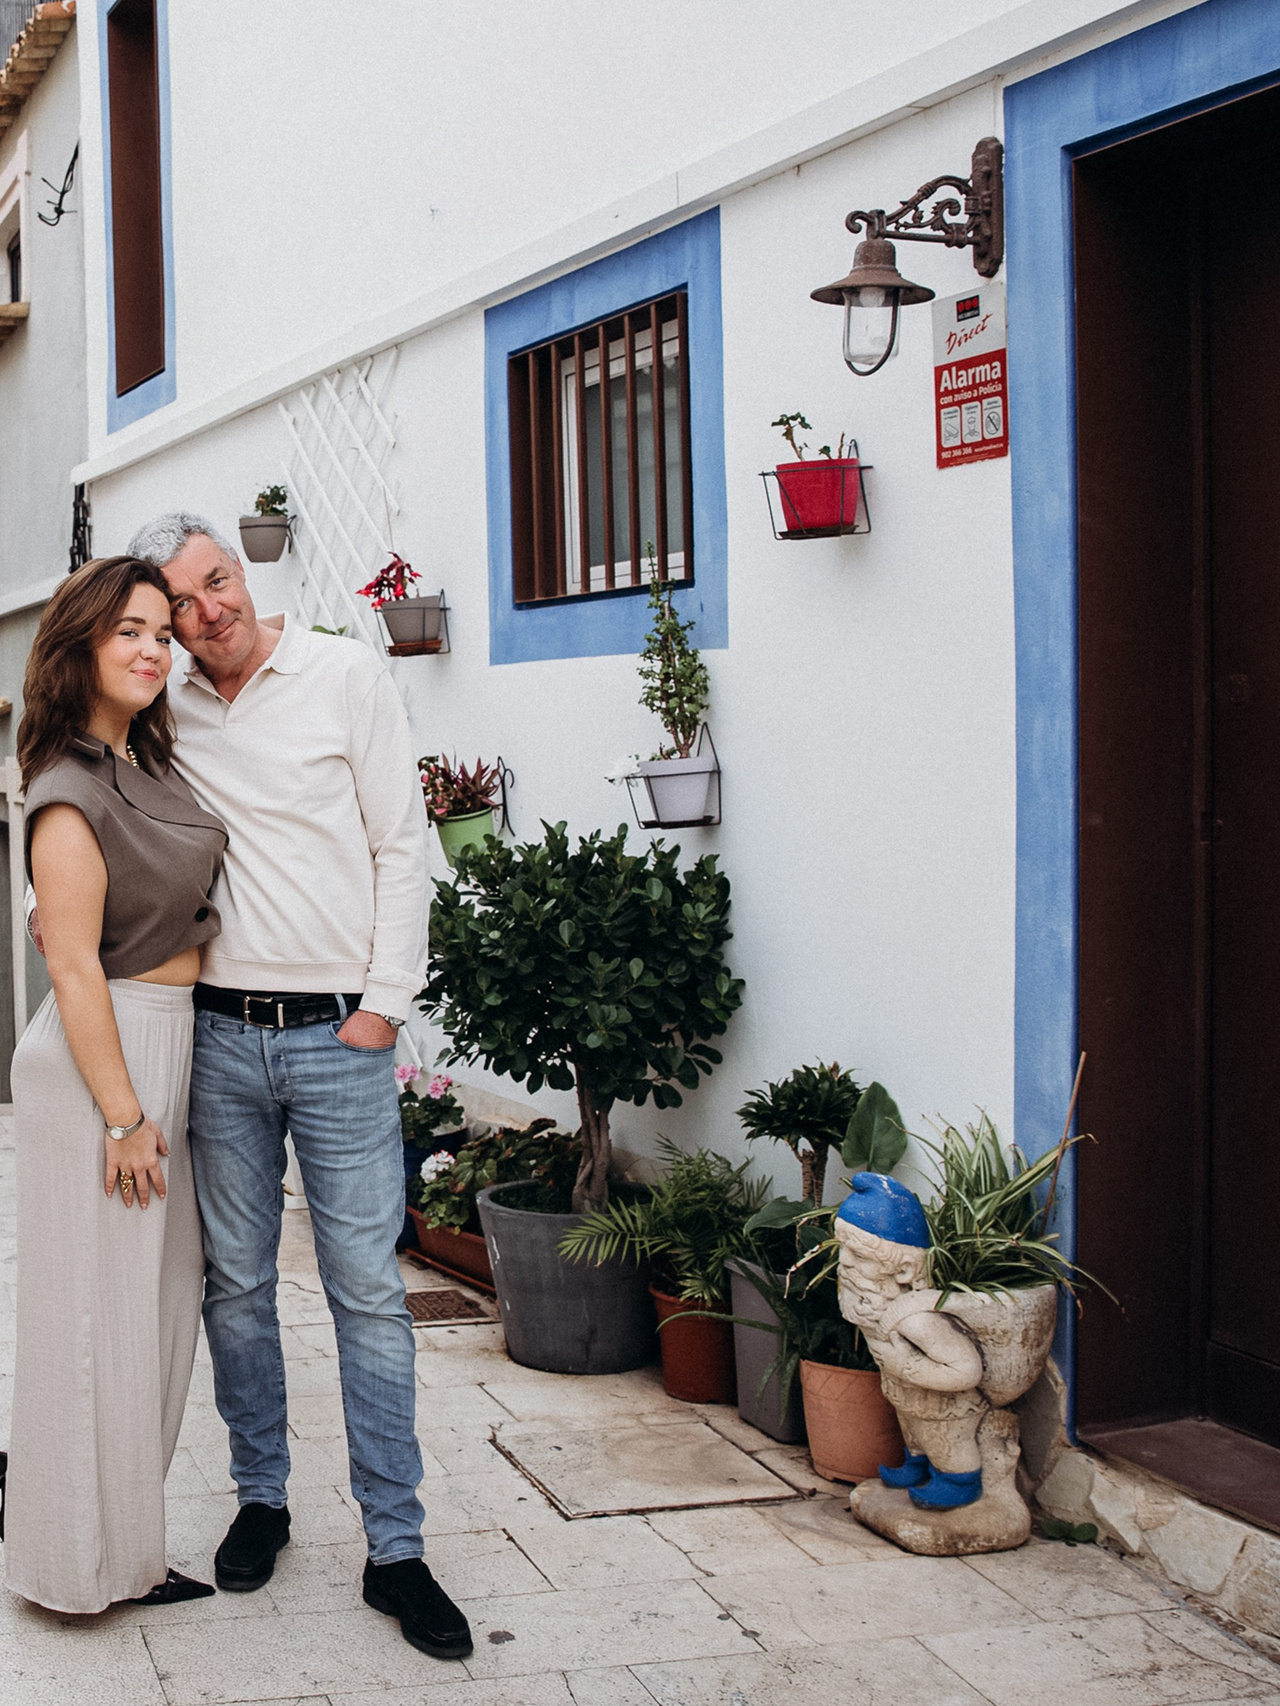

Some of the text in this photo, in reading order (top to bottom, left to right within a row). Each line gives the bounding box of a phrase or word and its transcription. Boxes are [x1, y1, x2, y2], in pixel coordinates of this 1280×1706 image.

[945, 313, 993, 355] Direct
[939, 361, 1002, 392] Alarma
[939, 395, 953, 405] con
[953, 390, 972, 402] aviso
[972, 389, 978, 397] a
